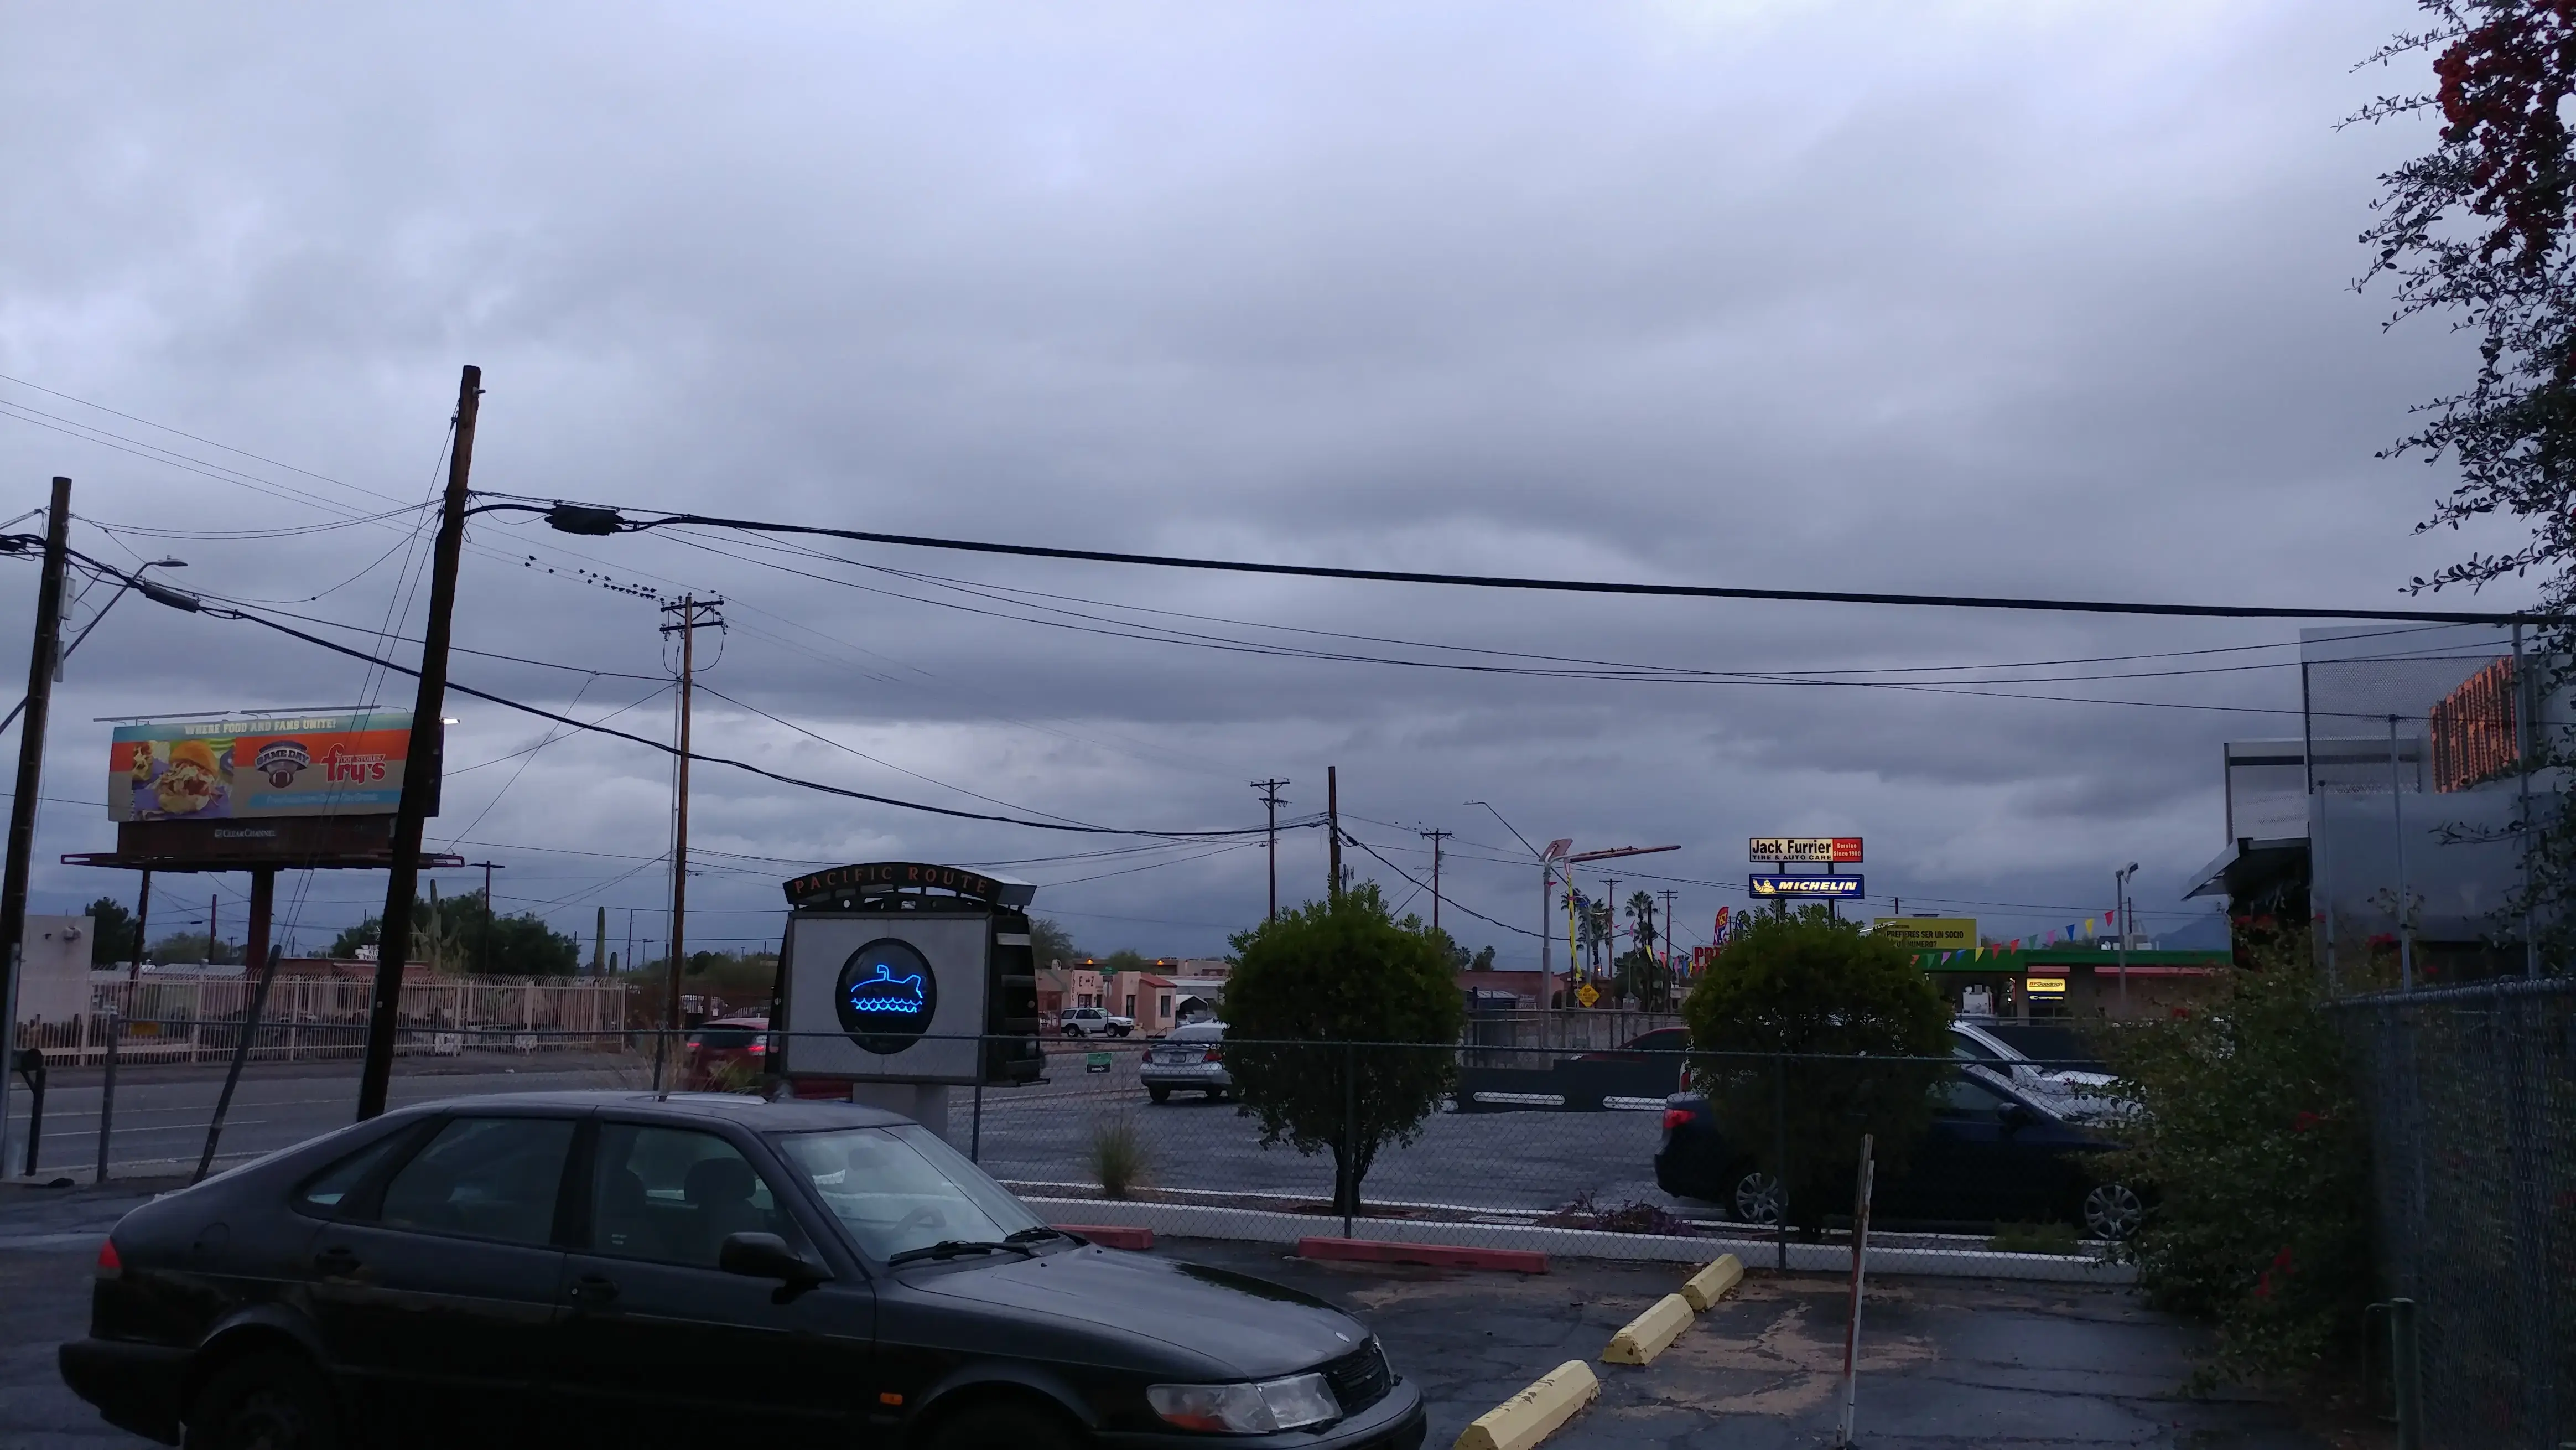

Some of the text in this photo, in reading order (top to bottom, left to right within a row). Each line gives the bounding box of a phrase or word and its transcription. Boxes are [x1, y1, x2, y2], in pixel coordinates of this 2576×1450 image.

[185, 718, 336, 734] WHERE FOOD AND FANS UNITE!
[256, 749, 309, 765] GAME DAY
[1752, 839, 1831, 854] Jack Furrier
[794, 867, 987, 894] PACIFIC ROUTE
[1778, 881, 1857, 891] MICHELIN
